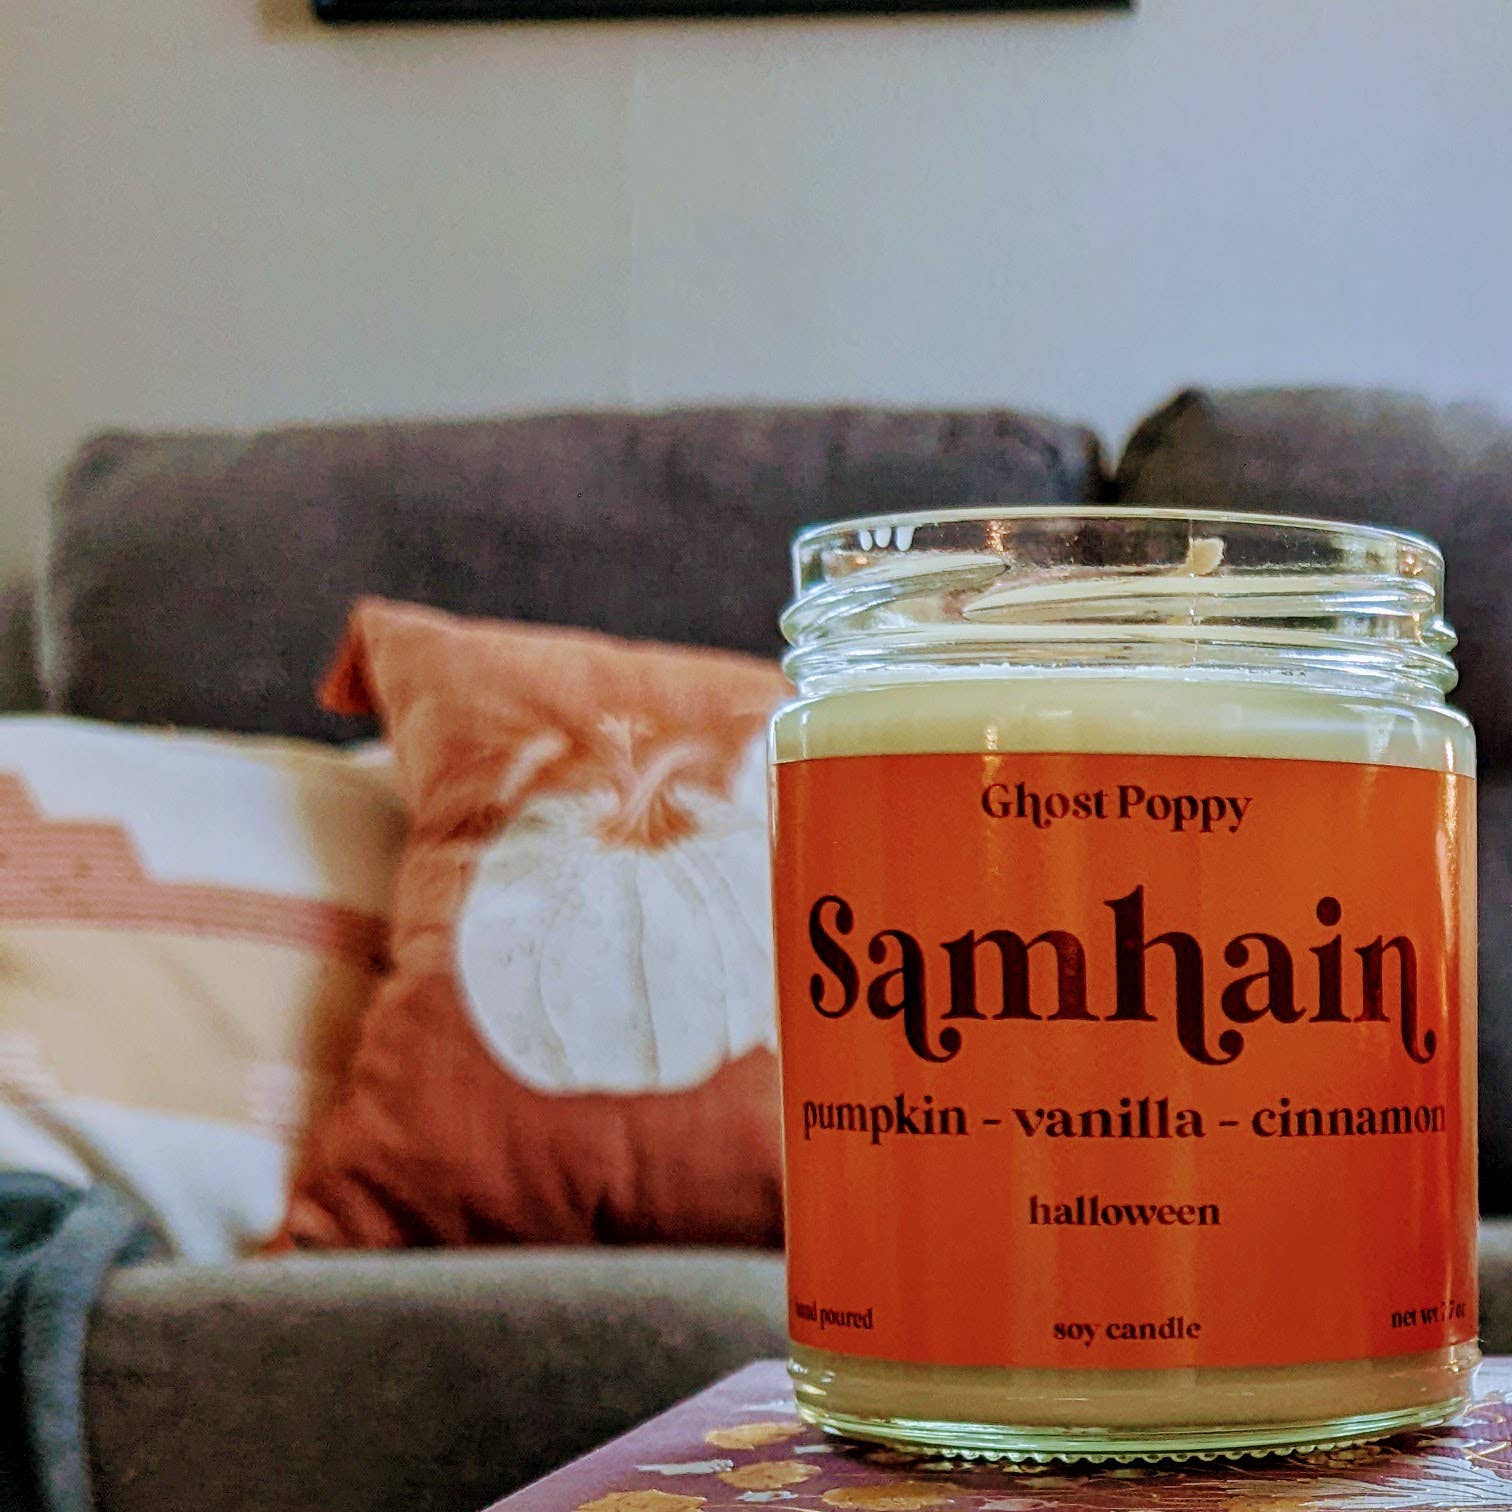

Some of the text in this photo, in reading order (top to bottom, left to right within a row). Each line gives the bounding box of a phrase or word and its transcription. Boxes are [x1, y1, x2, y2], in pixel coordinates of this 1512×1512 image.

[981, 781, 1253, 833] Ghost Poppy
[808, 885, 1437, 1066] Samhain
[803, 1093, 970, 1147] pumpkin
[1012, 1096, 1206, 1139] vanilla
[1251, 1097, 1447, 1138] cinnamon
[1029, 1195, 1221, 1227] halloween
[819, 1307, 874, 1330] poured
[1053, 1316, 1202, 1347] soy candle
[1391, 1310, 1417, 1329] net
